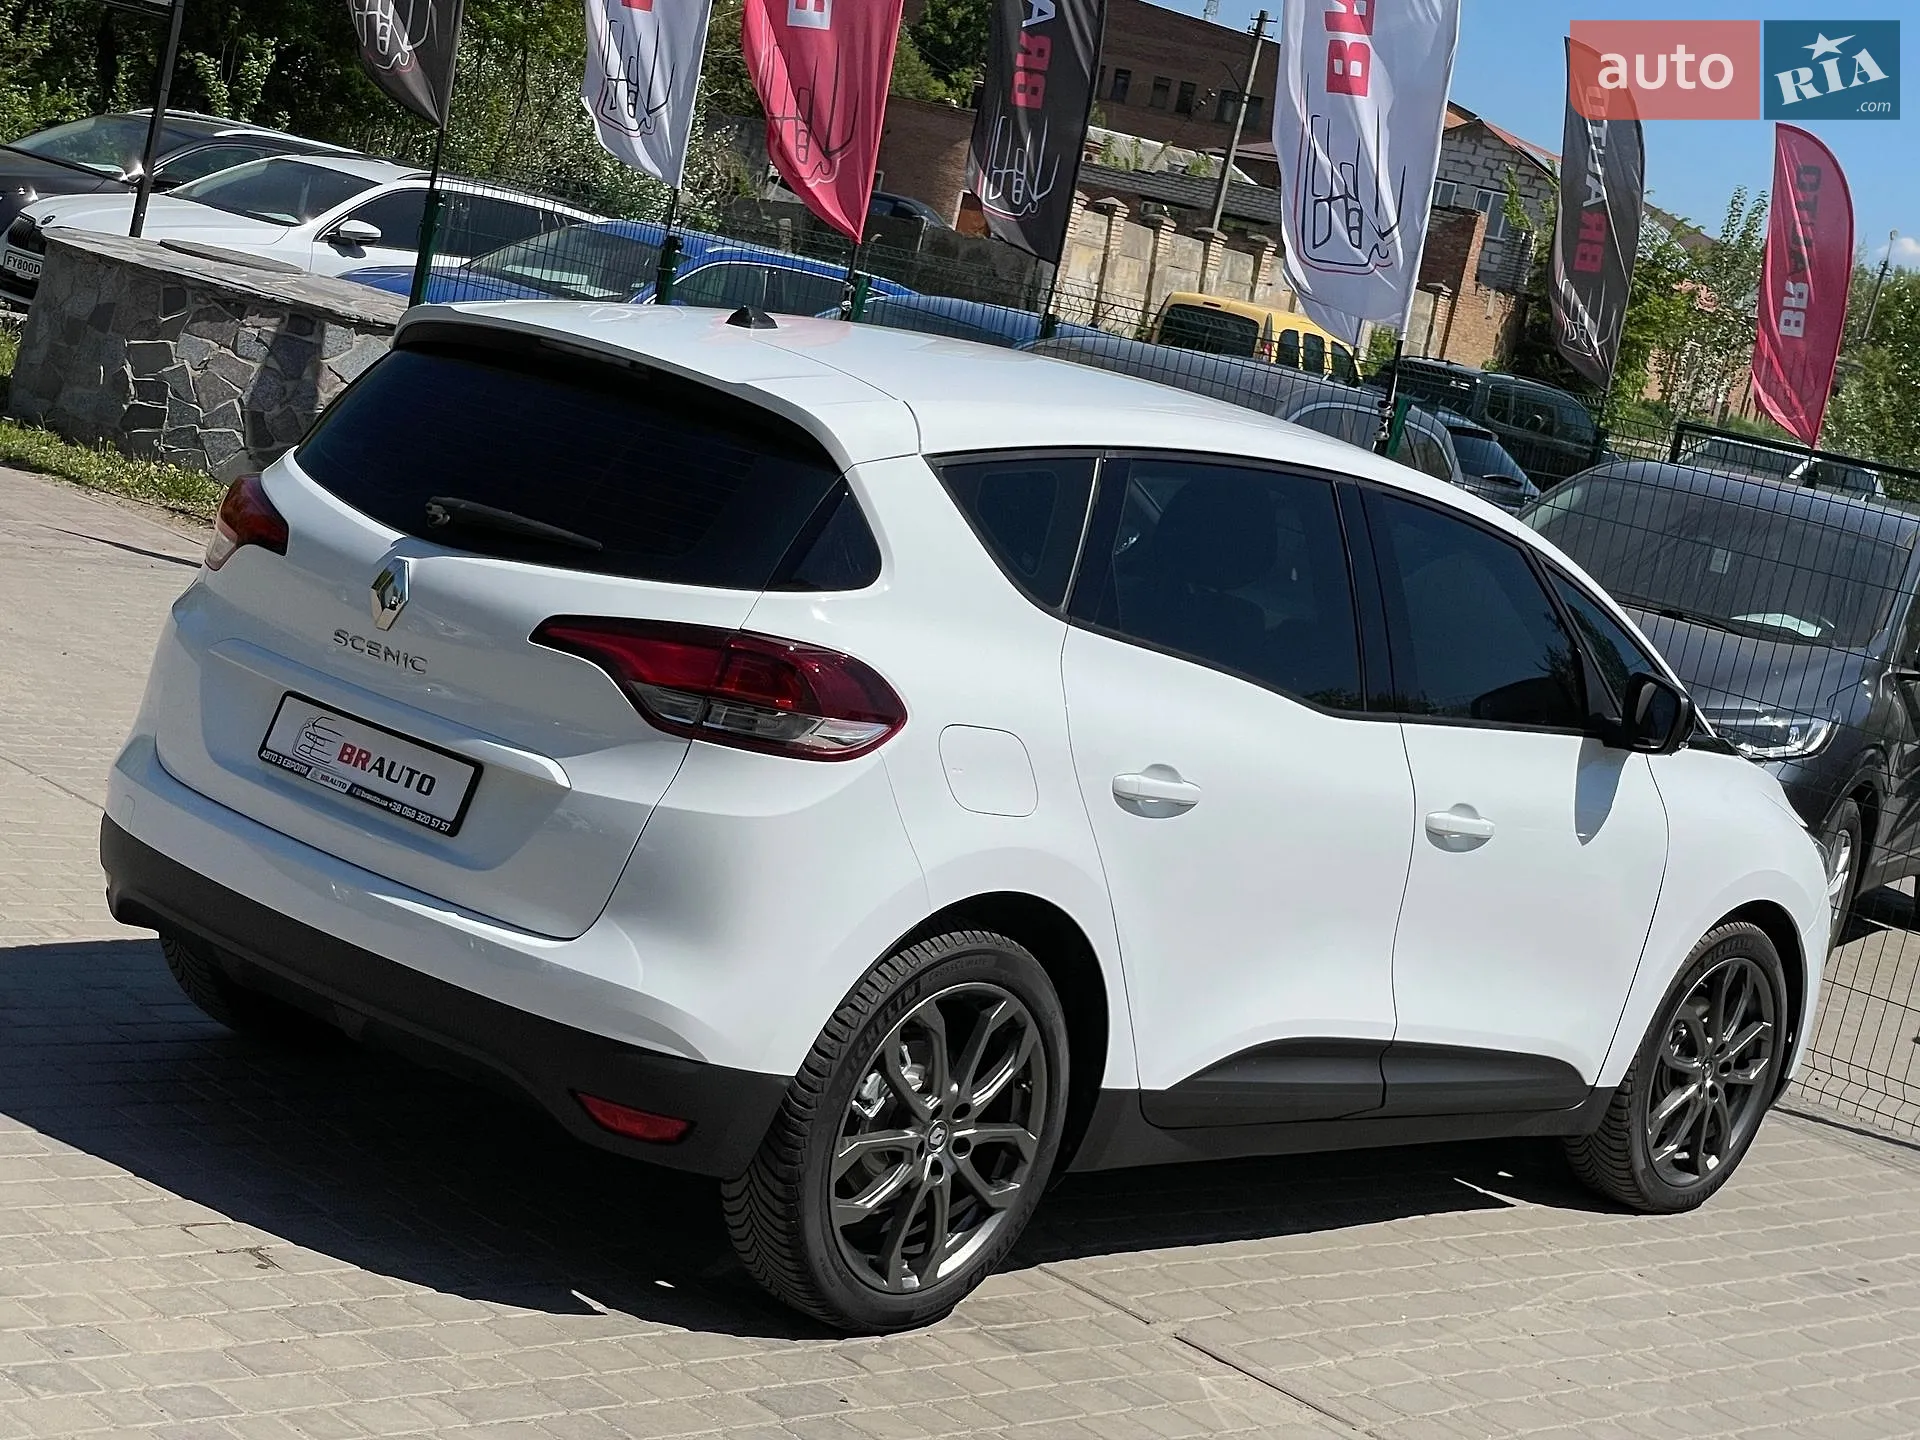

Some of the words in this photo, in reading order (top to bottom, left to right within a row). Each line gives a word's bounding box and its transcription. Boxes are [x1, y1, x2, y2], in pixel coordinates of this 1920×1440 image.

[333, 629, 429, 675] SCENIC
[260, 749, 278, 764] АВТО
[336, 742, 437, 797] BRAUTO
[320, 773, 347, 790] BRAUTO
[389, 801, 401, 814] +38
[416, 811, 431, 825] 320
[431, 817, 442, 829] 57
[440, 821, 451, 832] 57
